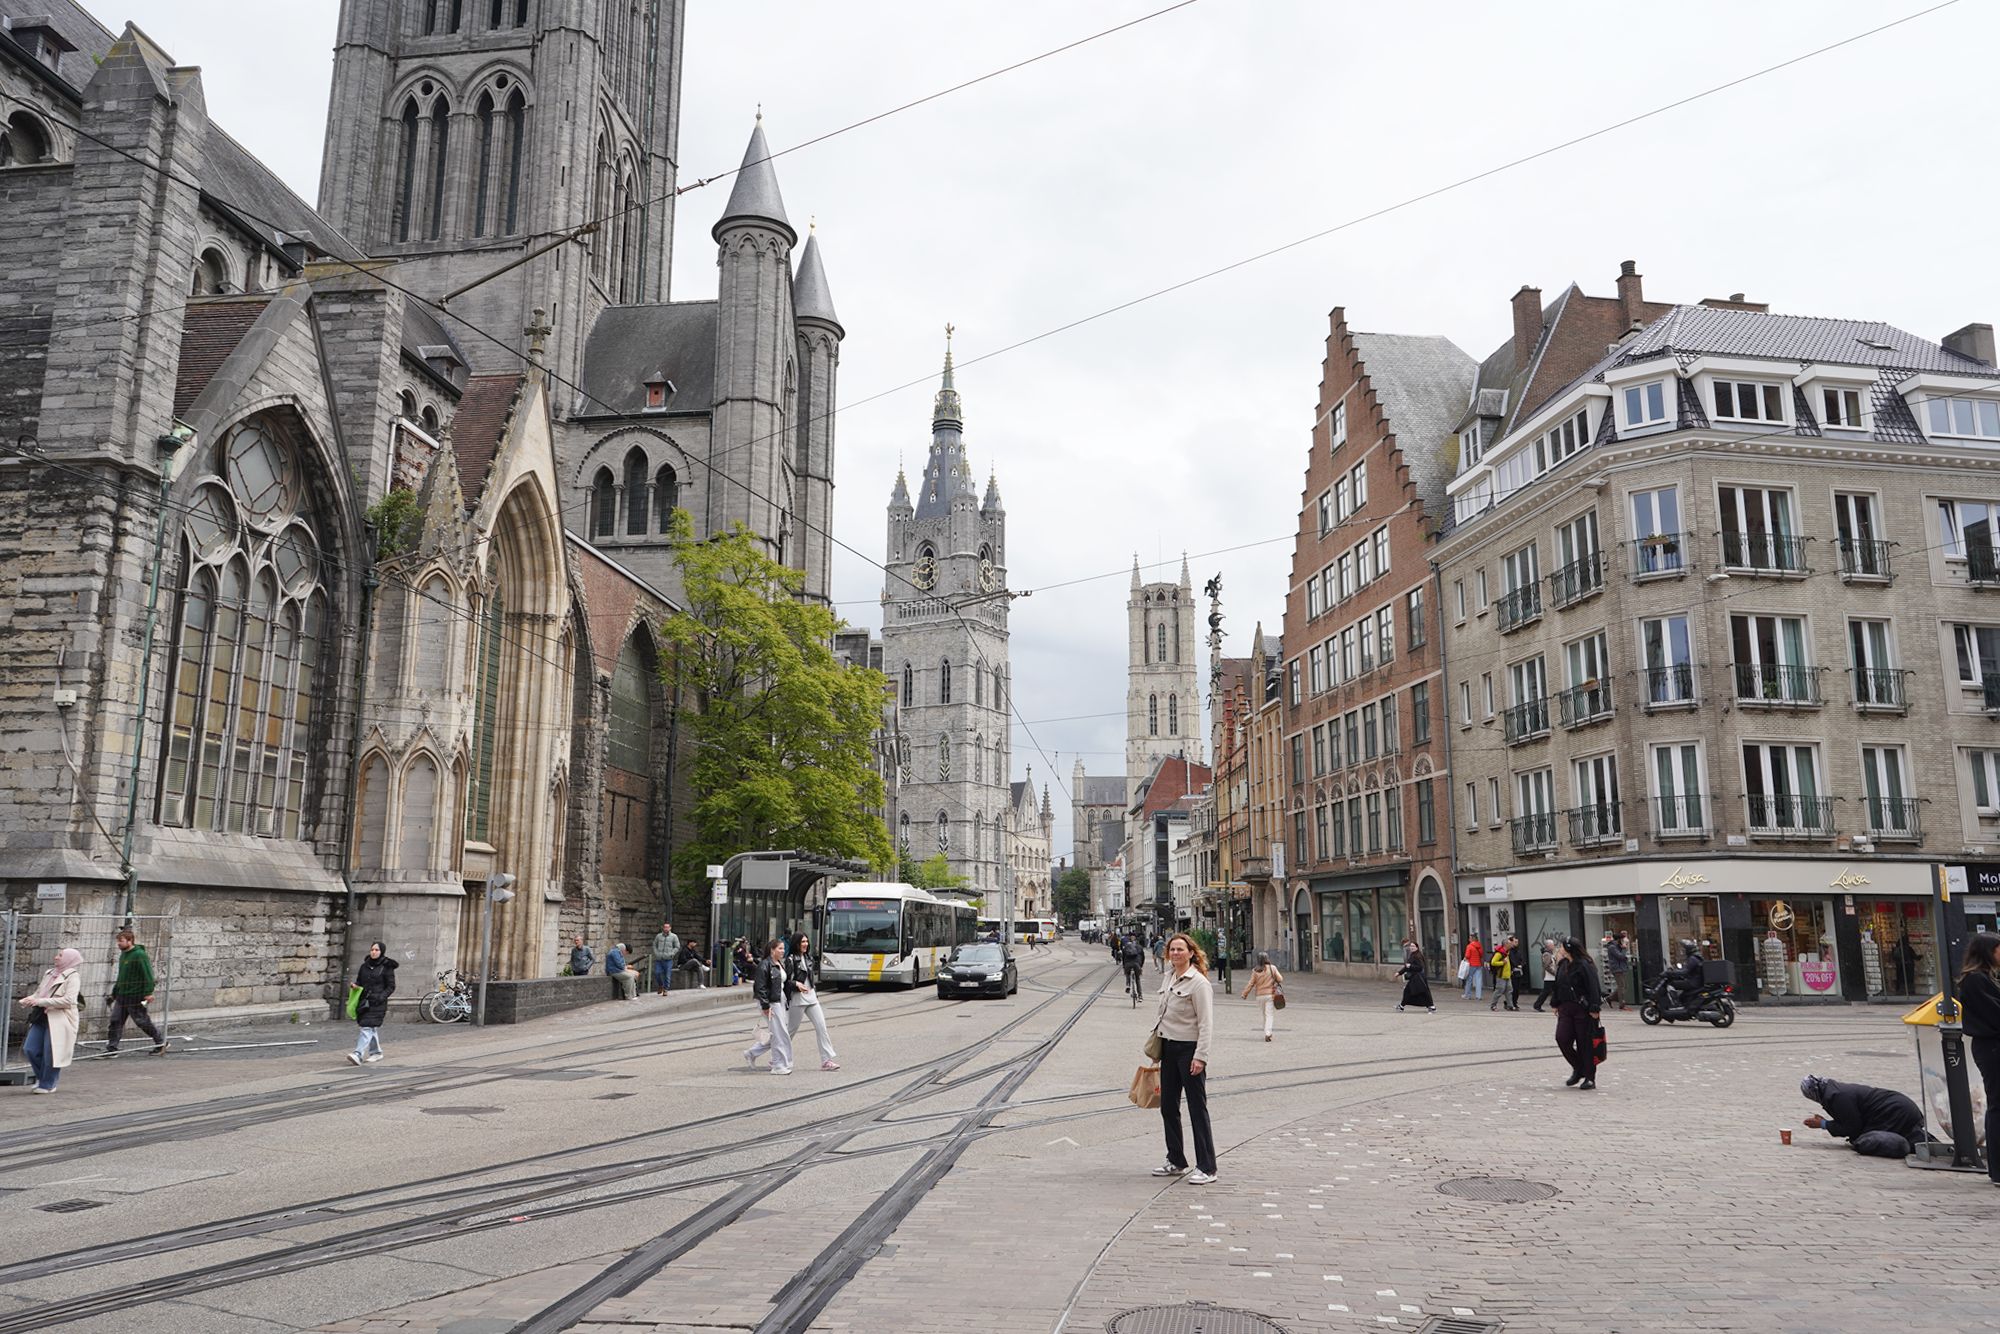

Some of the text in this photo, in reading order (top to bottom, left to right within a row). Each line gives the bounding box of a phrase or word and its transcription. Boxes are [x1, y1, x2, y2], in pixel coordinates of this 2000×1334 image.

[1660, 866, 1710, 889] Lovisa
[1830, 867, 1871, 890] Lovisa
[1979, 873, 2000, 884] Mo
[1805, 973, 1833, 983] 20% OFF
